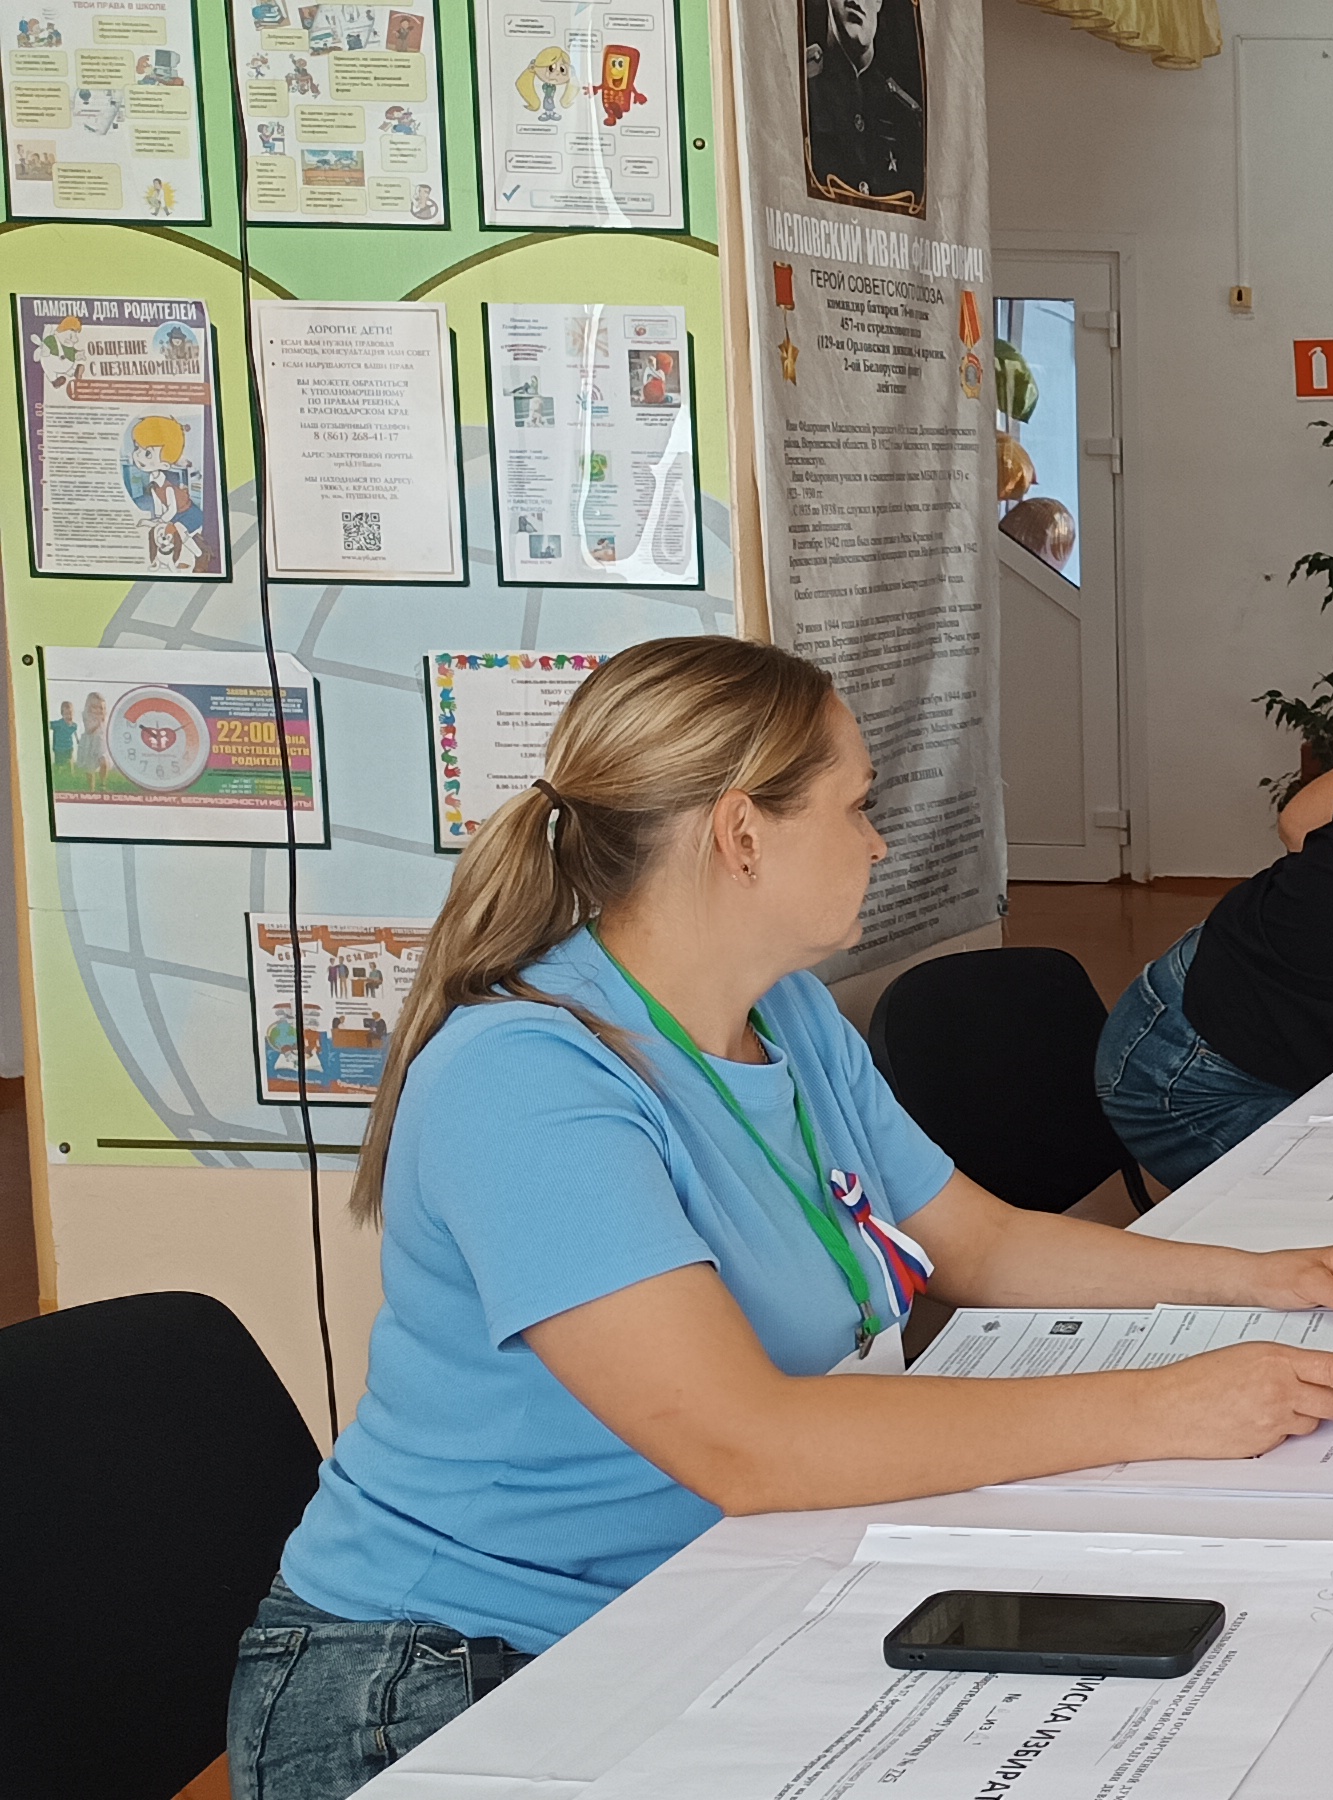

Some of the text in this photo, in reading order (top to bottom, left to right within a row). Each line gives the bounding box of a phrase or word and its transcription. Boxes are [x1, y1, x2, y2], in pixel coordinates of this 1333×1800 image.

[73, 1, 95, 9] ТВОИ
[866, 226, 910, 271] ИВАН
[810, 269, 845, 291] ГЕРОЙ
[34, 300, 197, 321] ПАМЯТКА ДЛЯ РОДИТЕЛЕЙ
[307, 324, 392, 336] ДОРОГИЕ ДЕТИ!
[88, 340, 148, 357] ОБЩЕНИЕ
[90, 360, 200, 376] С НЕЗНАКОМЦАМИ
[313, 379, 349, 387] МОЖЕТЕ
[311, 389, 405, 397] УПОЛНОМОЧЕННОМУ
[308, 407, 385, 416] КРАСНОДАРСКОМ
[313, 432, 399, 442] 8 (861) 268-41-17
[327, 452, 382, 460] ЭЛЕКТРОННОЙ
[123, 733, 132, 744] 9
[217, 721, 306, 745] 22:00 ОНА
[127, 749, 136, 761] 8
[212, 745, 309, 755] ОТВЕТСТВЕННСТИ
[139, 760, 148, 773] 7
[156, 764, 165, 777] 6
[171, 760, 181, 774] 5
[1207, 1611, 1248, 1661] ФЕДЕРАЛЬНОГО
[1211, 1650, 1237, 1678] ВЫБОРЫ
[1180, 1660, 1213, 1694] СОБРАНИЯ
[1043, 1676, 1106, 1724] ПИСКА
[1181, 1675, 1217, 1717] ДЕПУТАТОВ
[1148, 1693, 1185, 1741] РОССИЙСКОЙ
[1127, 1716, 1187, 1784] ГОСУДАРСТВЕННОЙ
[1109, 1740, 1149, 1782] ФЕДЕРАЦИИ
